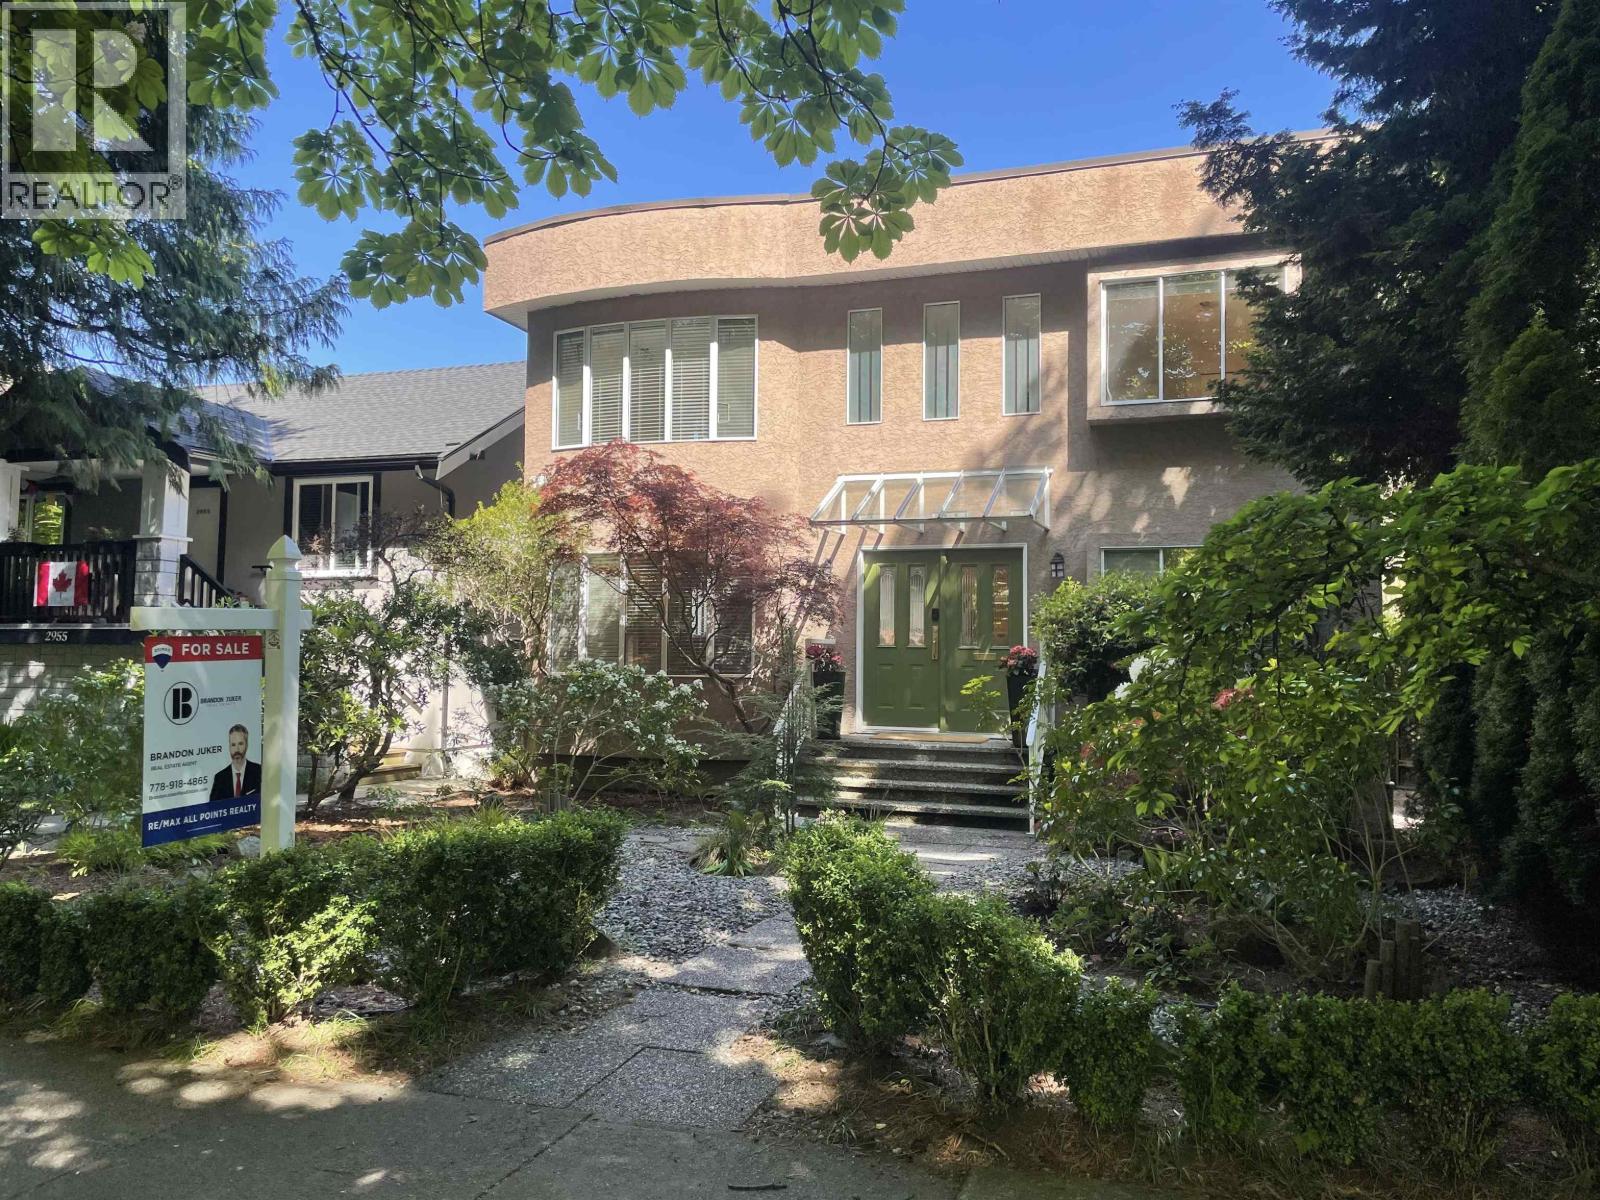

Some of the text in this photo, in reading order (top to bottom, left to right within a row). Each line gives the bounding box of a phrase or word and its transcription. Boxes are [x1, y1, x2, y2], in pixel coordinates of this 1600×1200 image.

[44, 631, 68, 641] 2955
[181, 643, 211, 656] FOR
[216, 642, 250, 655] SALE
[150, 745, 223, 762] BRANDON JUKER
[149, 775, 208, 793] 778-918-4865
[148, 803, 257, 831] RE/MAX ALL POINTS REALTY
